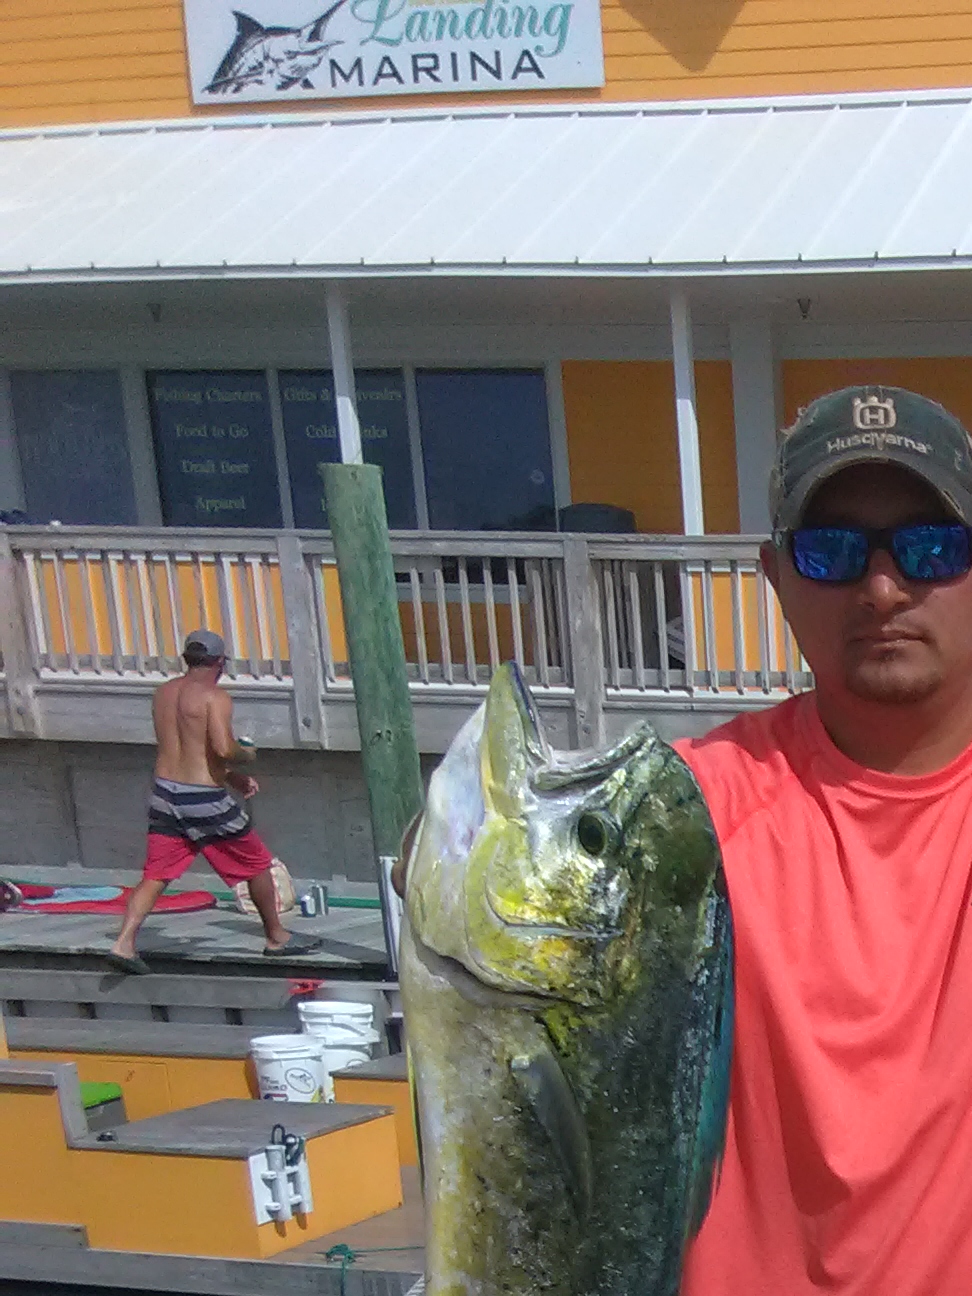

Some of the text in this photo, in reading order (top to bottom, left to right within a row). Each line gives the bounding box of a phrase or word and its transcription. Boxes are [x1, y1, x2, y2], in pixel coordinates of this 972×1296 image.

[350, 0, 575, 57] Landing
[328, 48, 546, 88] MARINA
[175, 422, 250, 438] Food to Go
[306, 424, 337, 438] Cold
[826, 431, 929, 454] Husqvarna
[221, 460, 250, 474] Beer
[196, 496, 246, 512] Apparel
